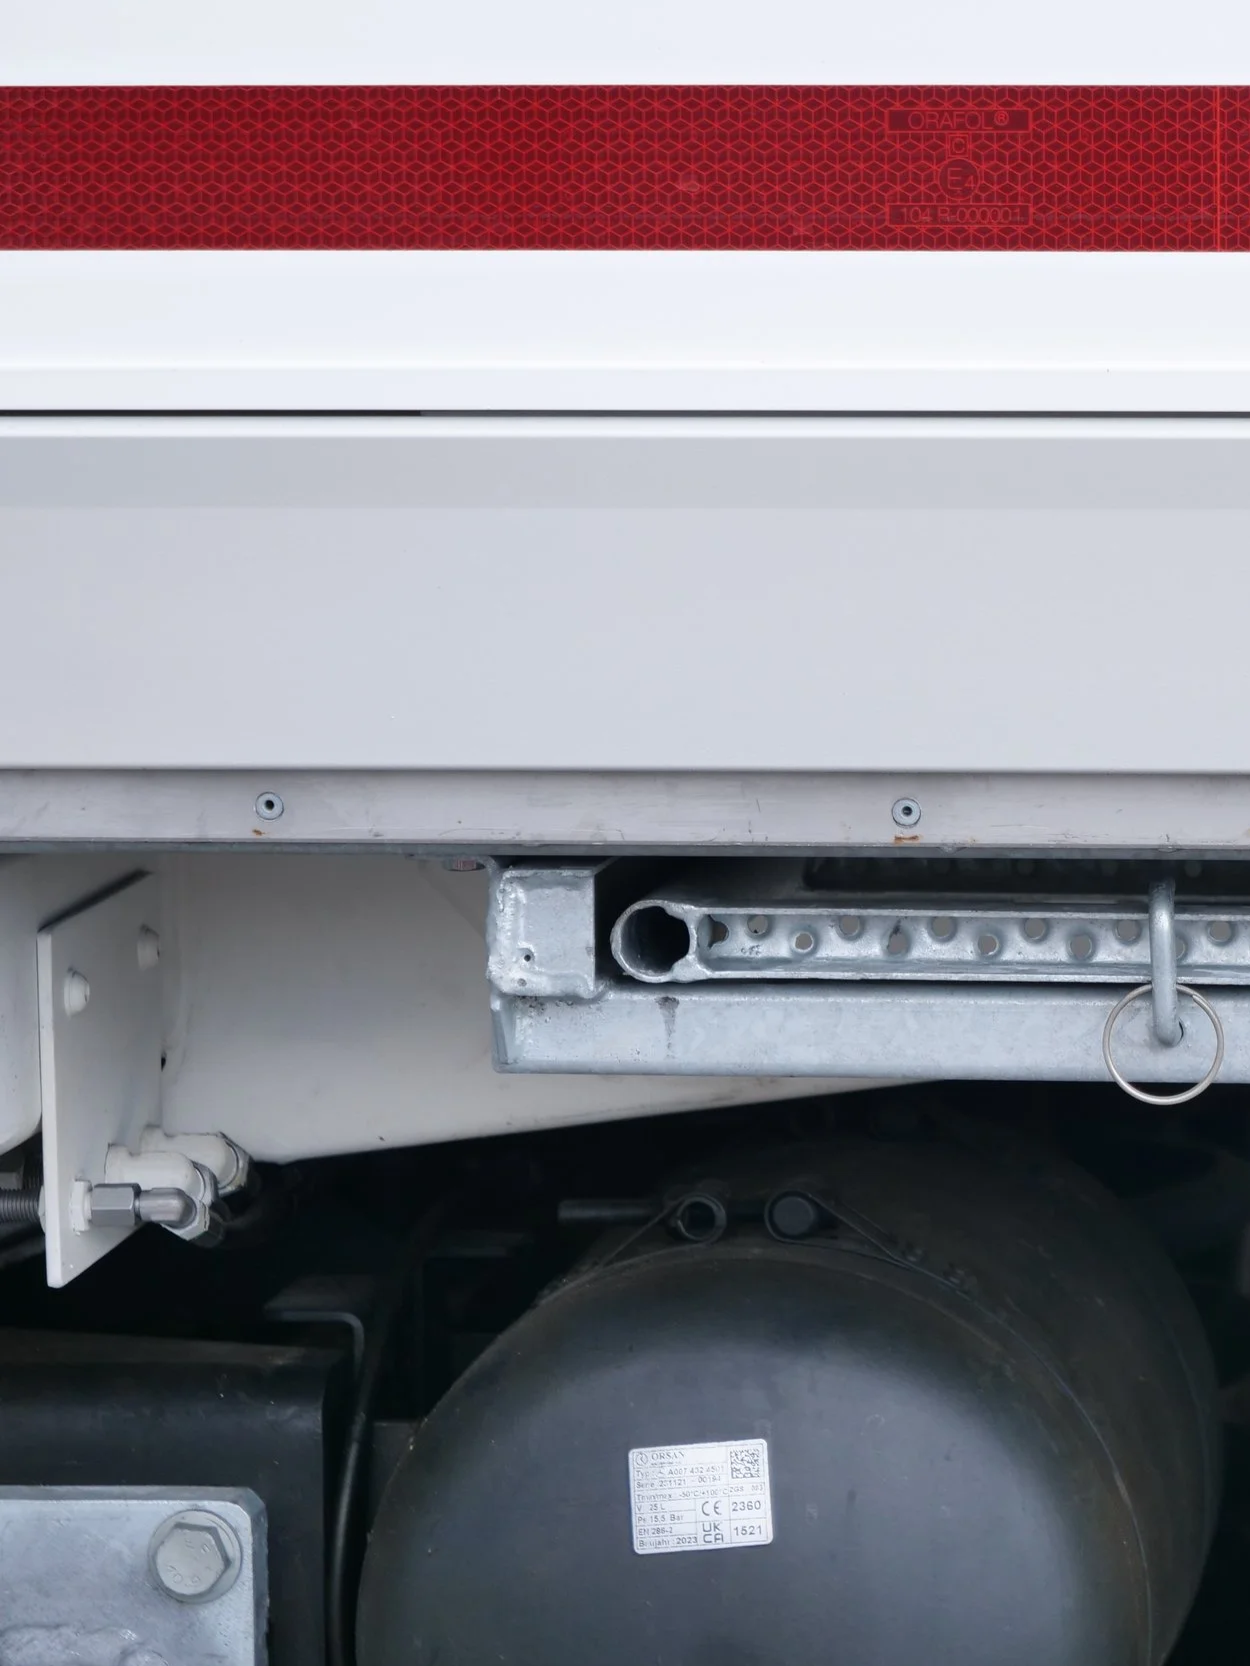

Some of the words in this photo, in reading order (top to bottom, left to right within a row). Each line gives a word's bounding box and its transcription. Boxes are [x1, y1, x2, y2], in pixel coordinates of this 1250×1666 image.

[732, 1500, 761, 1512] 2360
[702, 1523, 721, 1532] UK
[734, 1526, 762, 1536] 1521
[703, 1534, 724, 1543] CA
